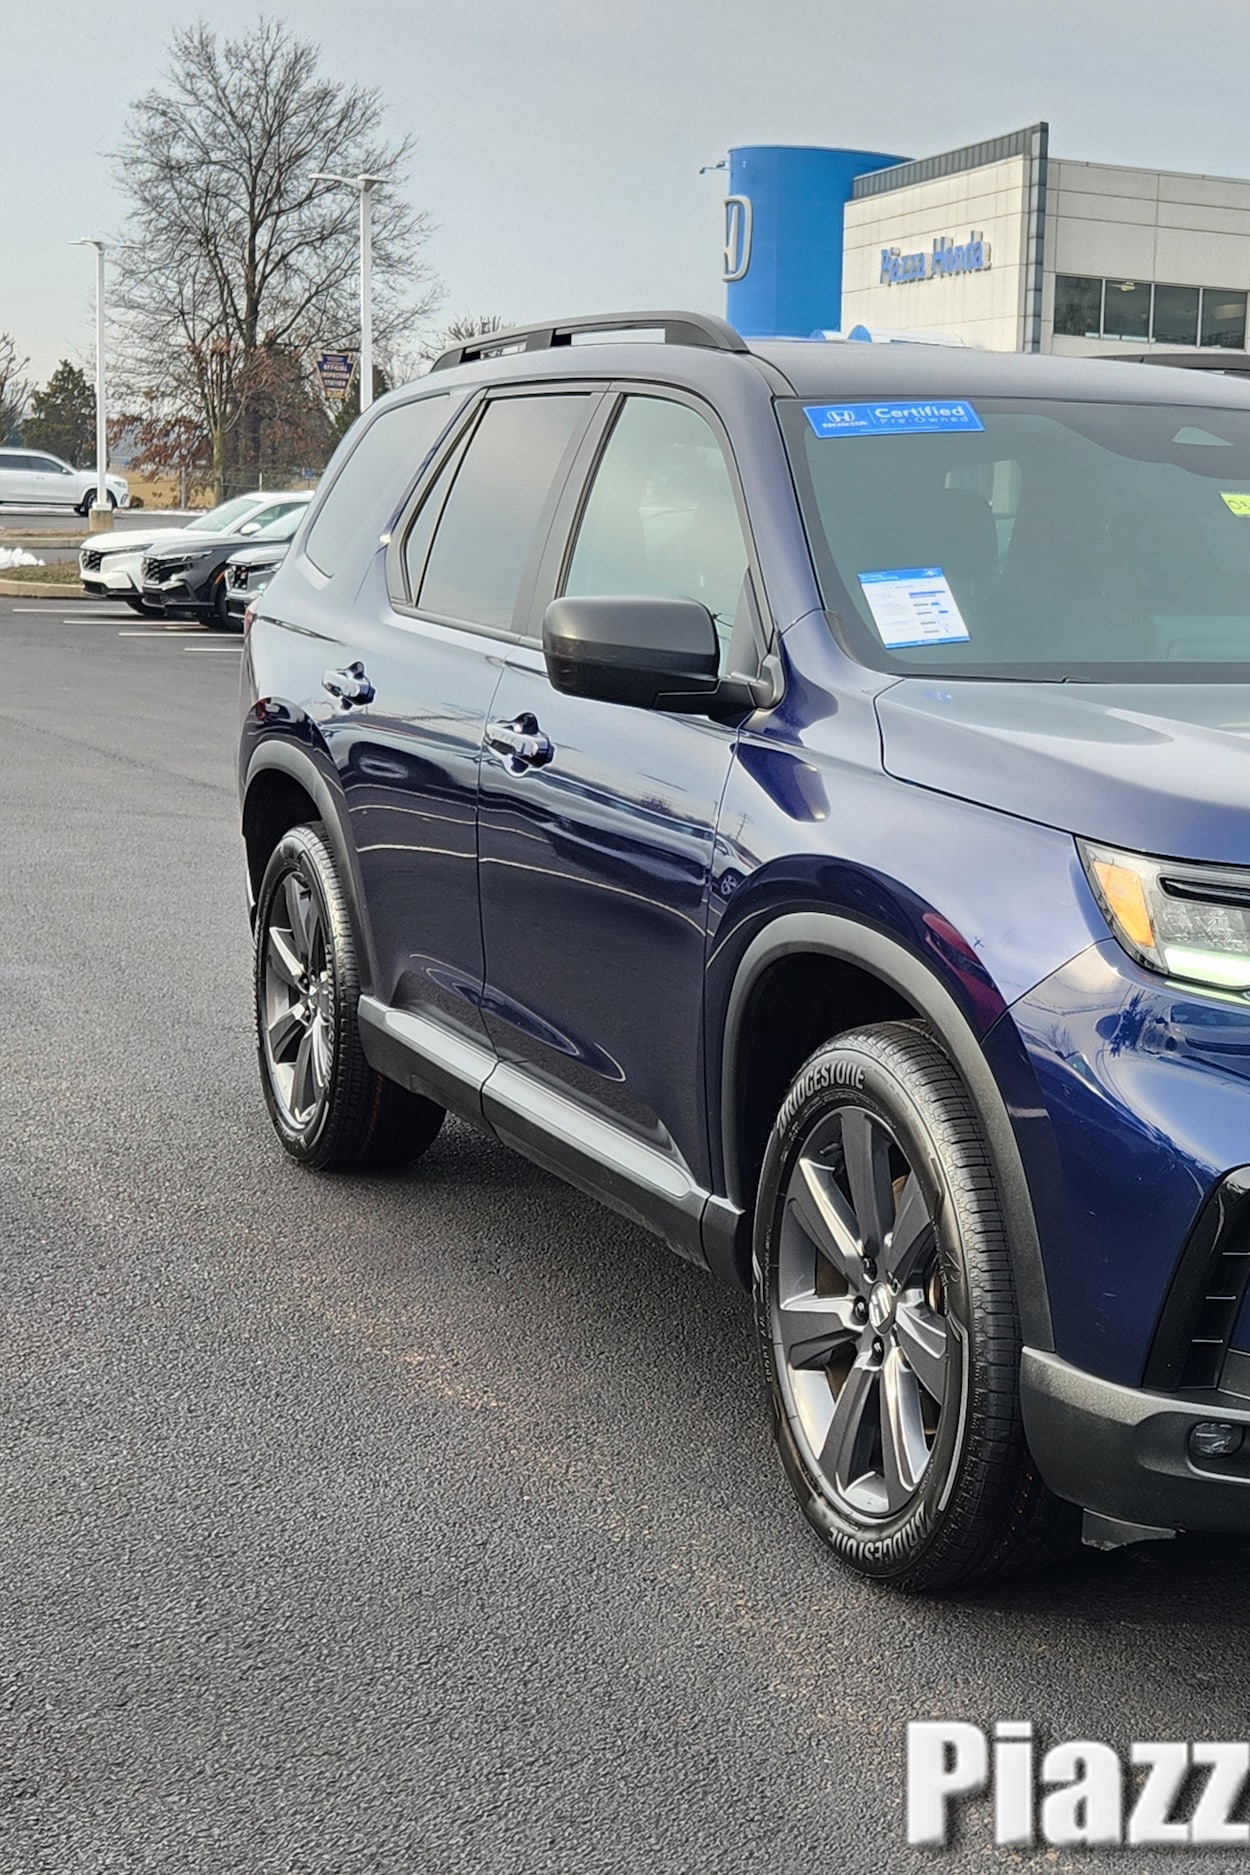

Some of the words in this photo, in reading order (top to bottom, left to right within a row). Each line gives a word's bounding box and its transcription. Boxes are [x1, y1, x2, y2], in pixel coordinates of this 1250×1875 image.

[880, 247, 930, 284] Piazza
[932, 231, 990, 276] Honda
[874, 405, 965, 419] Certified
[880, 415, 969, 425] Pre-Owned
[776, 1061, 865, 1140] BRIDGESTONE
